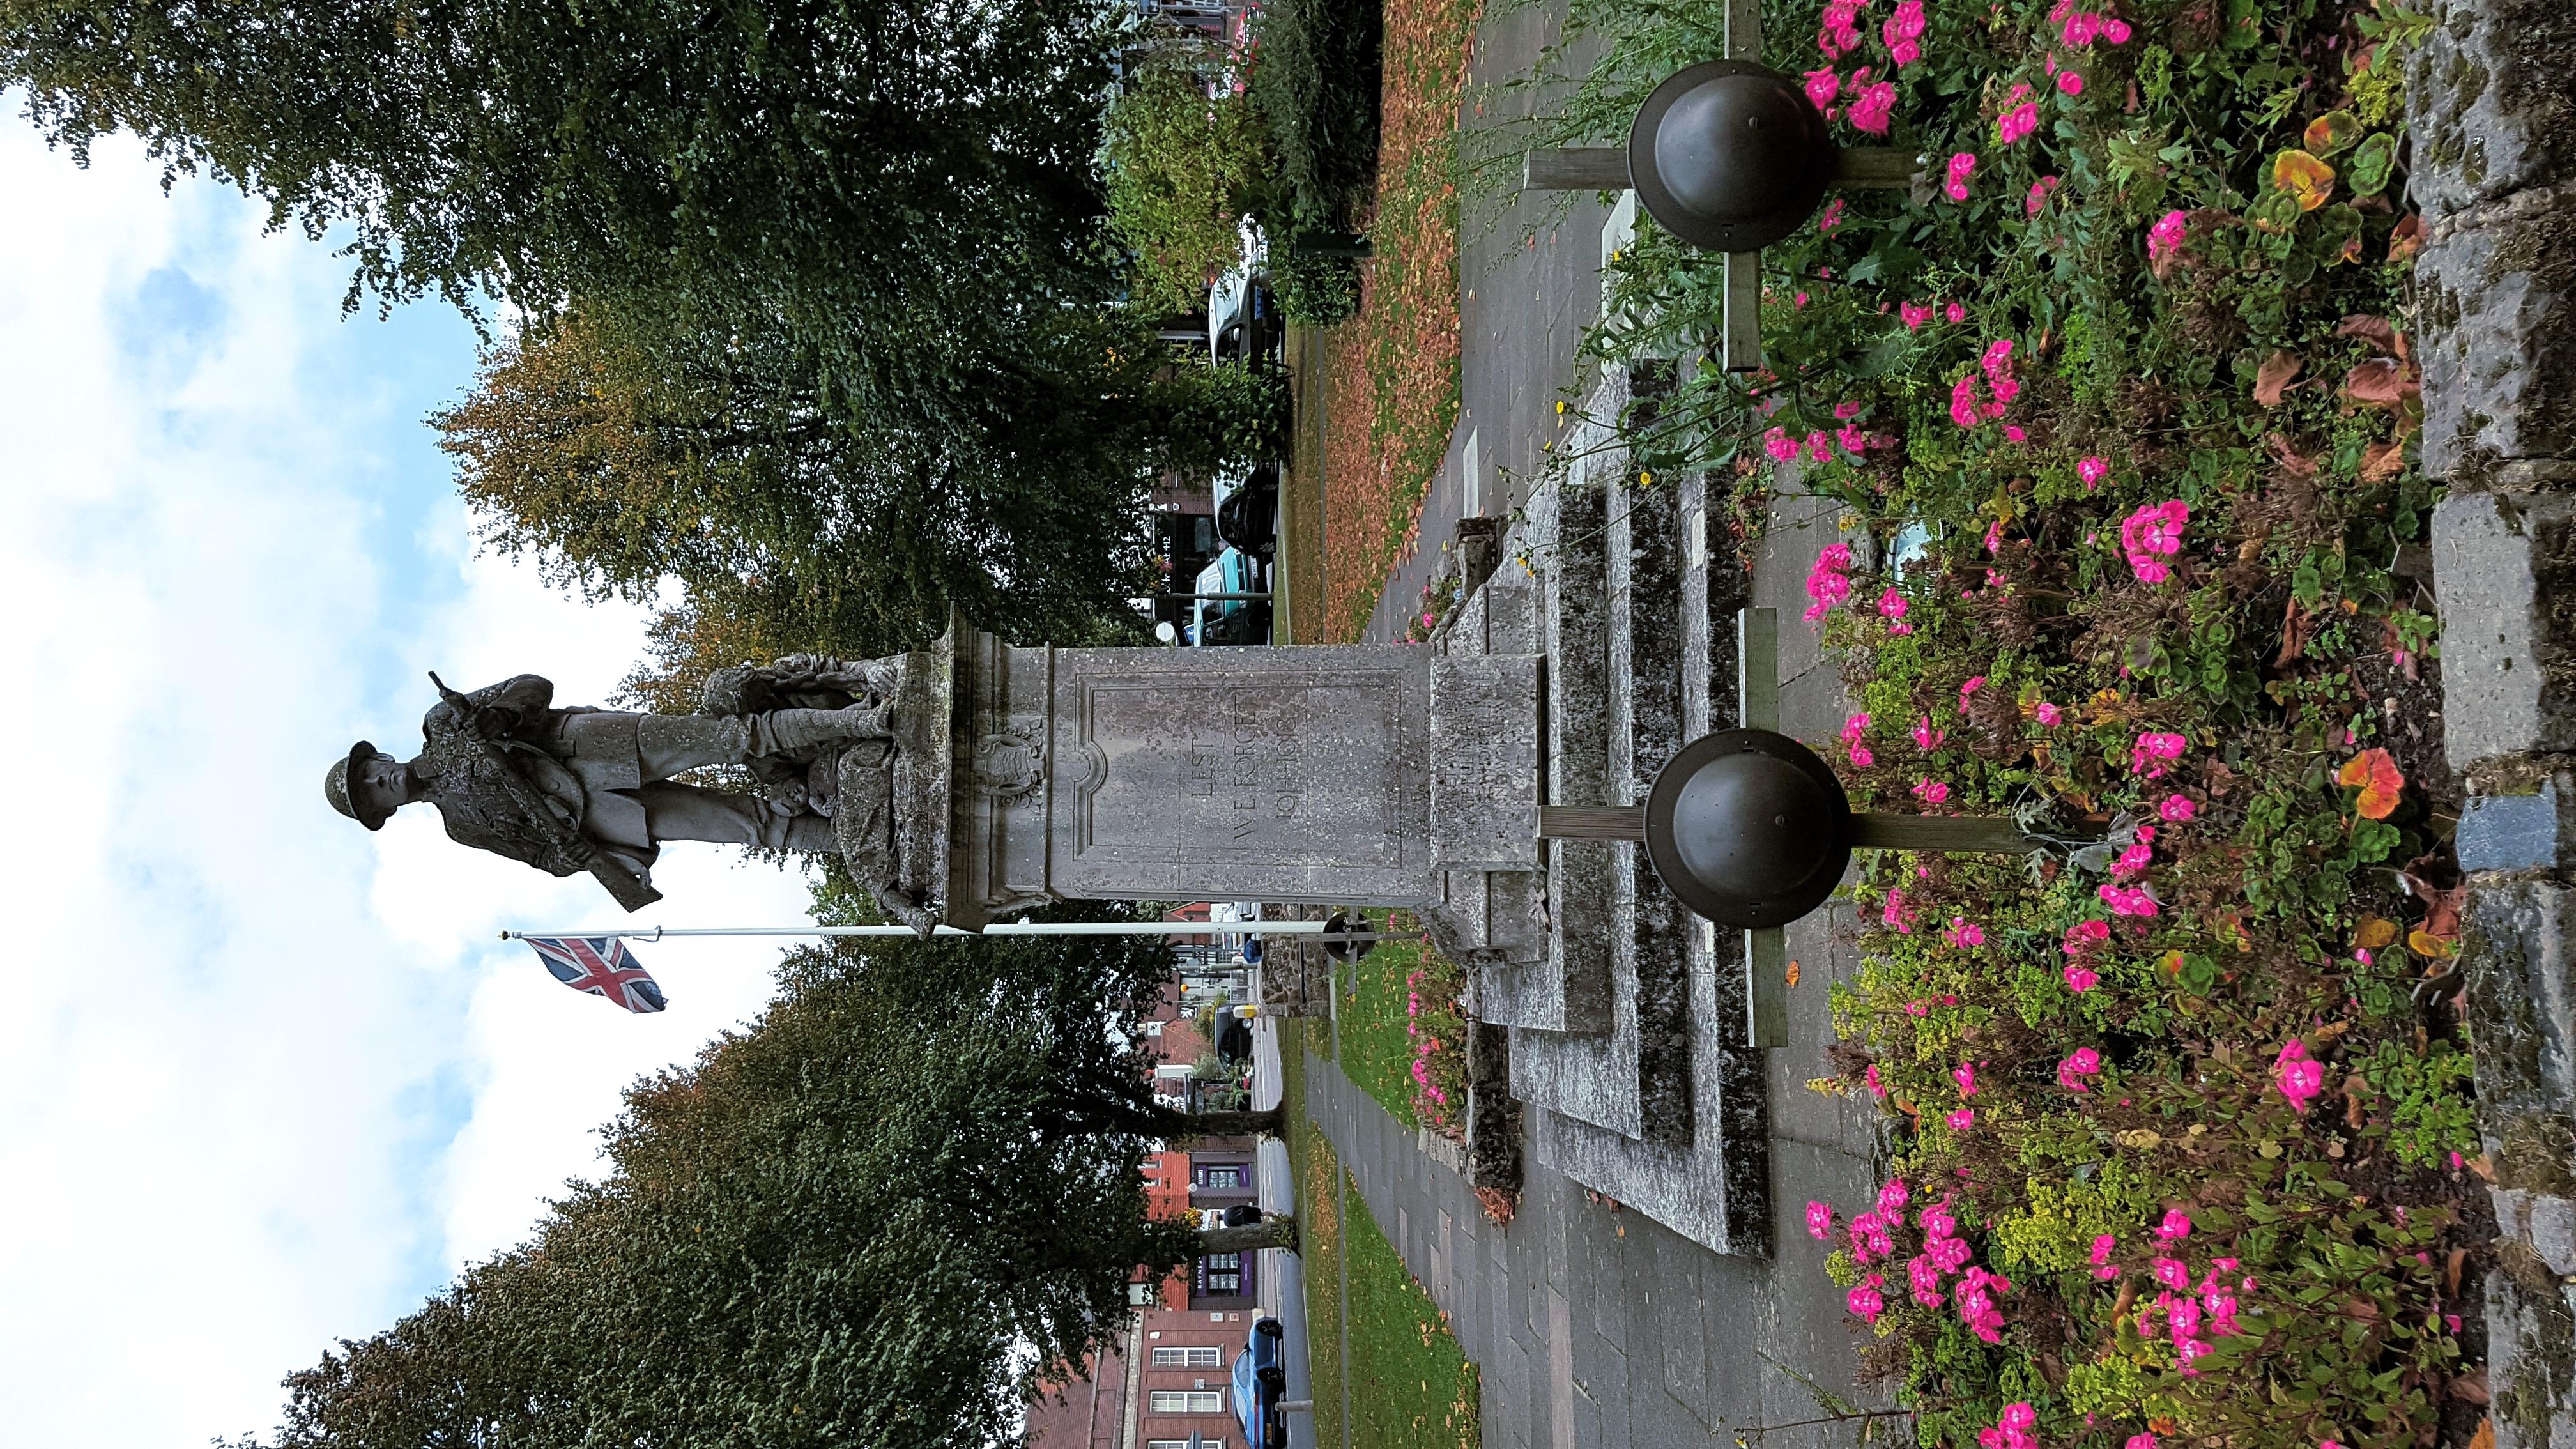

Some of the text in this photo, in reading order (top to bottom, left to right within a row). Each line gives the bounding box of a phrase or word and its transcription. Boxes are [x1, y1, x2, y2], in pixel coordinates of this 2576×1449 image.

[1191, 737, 1213, 798] LEST
[1234, 695, 1257, 840] WE FORGET
[1460, 756, 1475, 838] GRATEFUL
